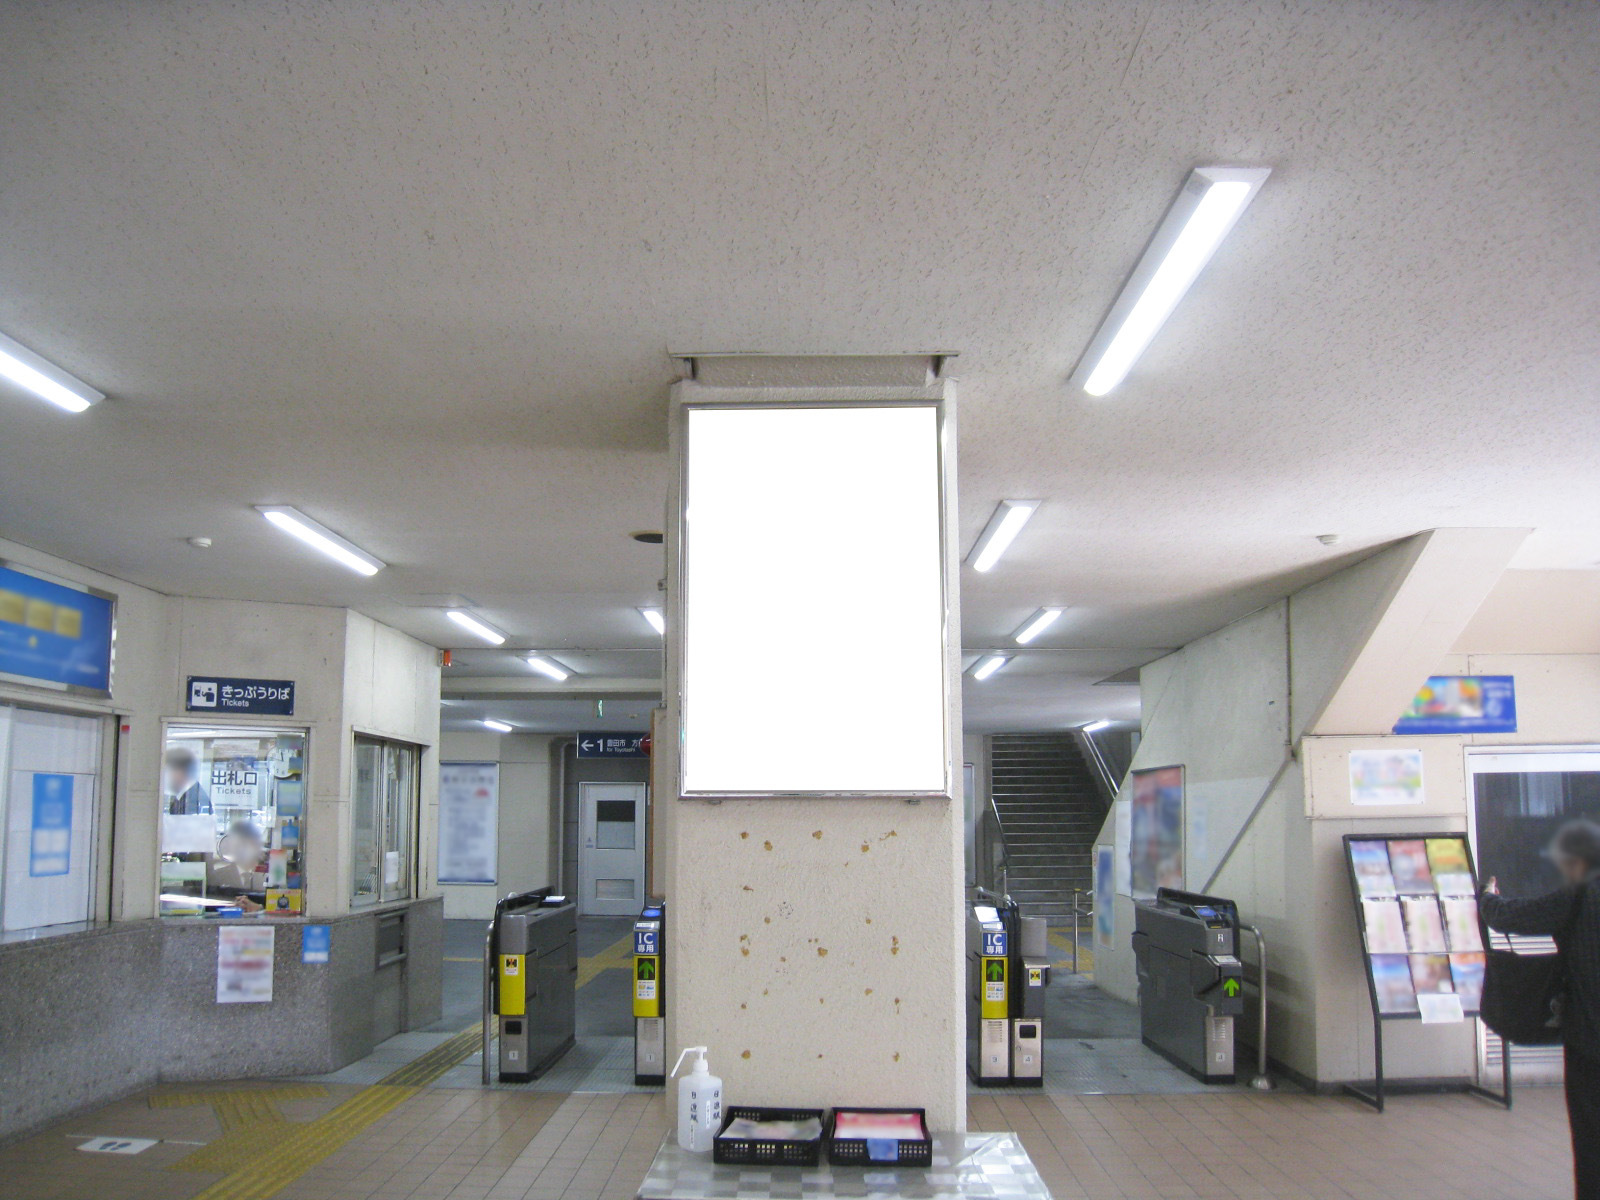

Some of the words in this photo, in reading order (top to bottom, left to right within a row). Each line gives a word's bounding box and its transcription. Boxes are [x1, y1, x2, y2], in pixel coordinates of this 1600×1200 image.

[221, 685, 290, 700] きっぷうりば
[222, 699, 249, 707] Tickets
[597, 739, 603, 752] 1
[212, 770, 257, 785] 出札口
[638, 932, 654, 944] IC
[987, 933, 1003, 945] IC
[637, 944, 654, 953] 専用
[986, 945, 1003, 954] 専用
